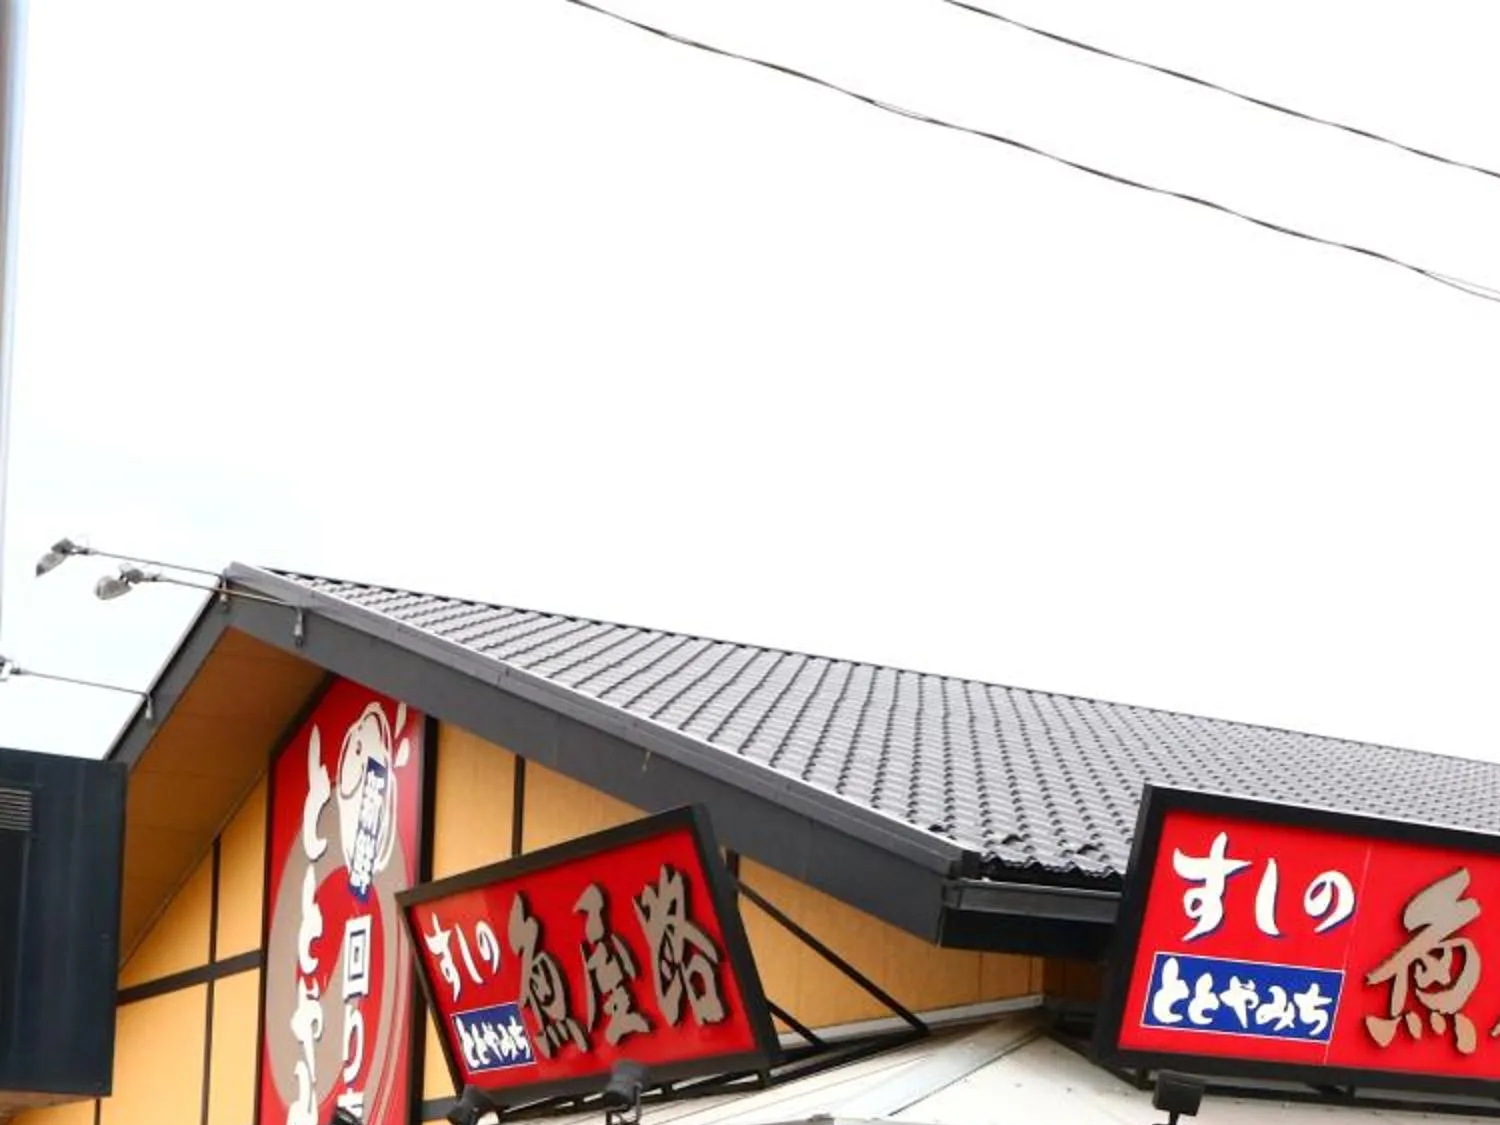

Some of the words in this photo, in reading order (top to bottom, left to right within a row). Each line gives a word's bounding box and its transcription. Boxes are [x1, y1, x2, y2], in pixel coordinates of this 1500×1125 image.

[1172, 831, 1356, 942] すしの
[423, 911, 501, 1003] すしの
[508, 864, 722, 1057] 魚屋路
[1151, 957, 1333, 1038] ととやみち
[455, 1015, 533, 1068] ととやみち
